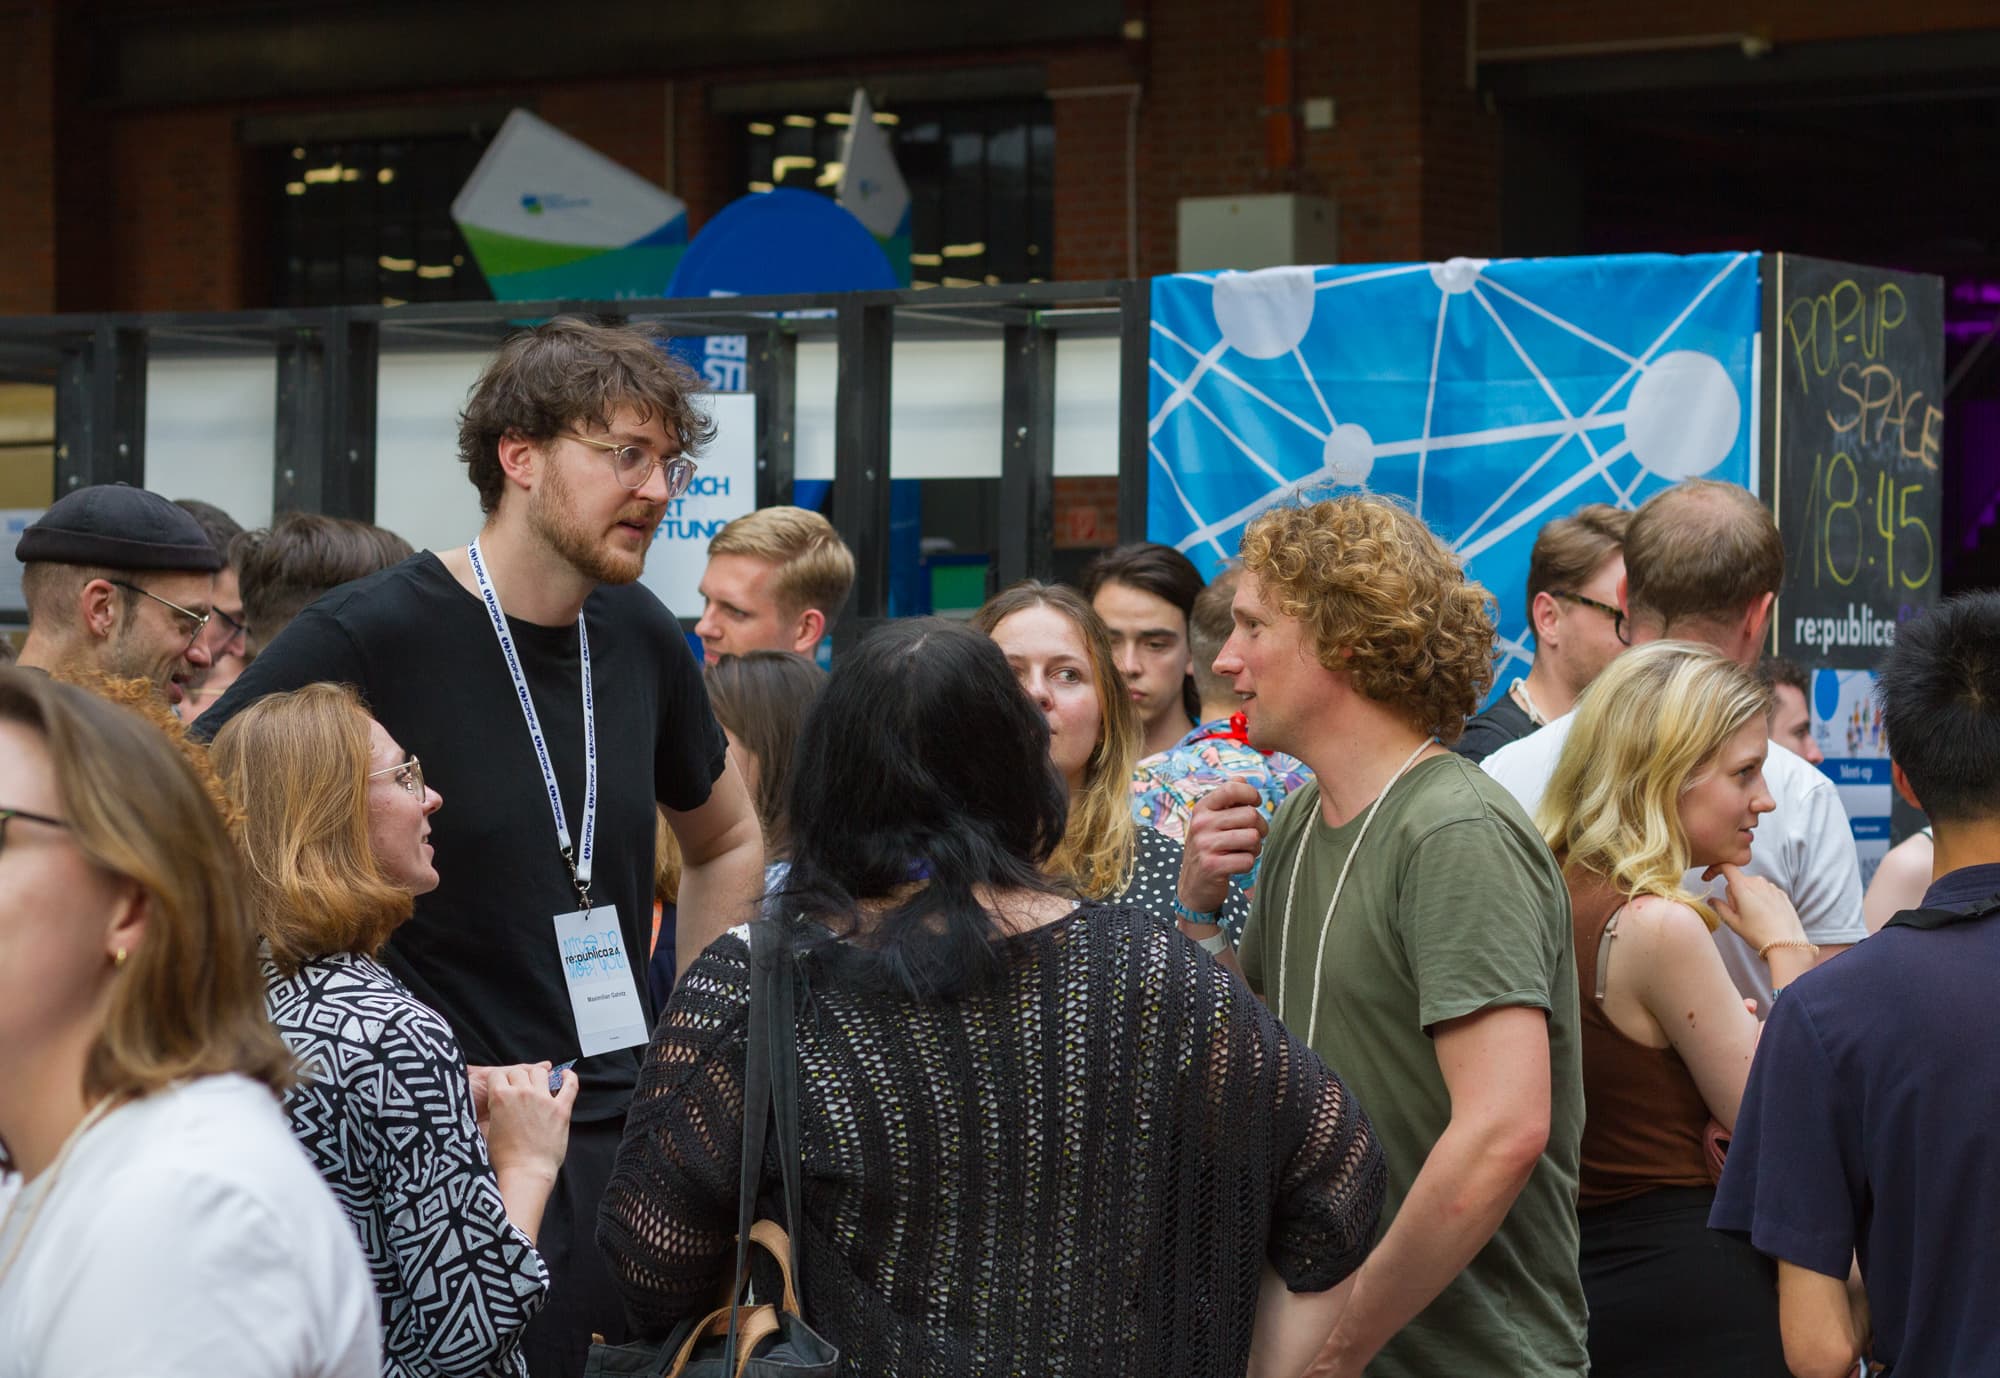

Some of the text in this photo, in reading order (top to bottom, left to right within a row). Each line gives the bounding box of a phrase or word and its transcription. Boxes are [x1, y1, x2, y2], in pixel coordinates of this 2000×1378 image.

[1784, 279, 1907, 395] POP-UP
[1826, 362, 1944, 470] SPACE
[1794, 452, 1934, 590] 18:45
